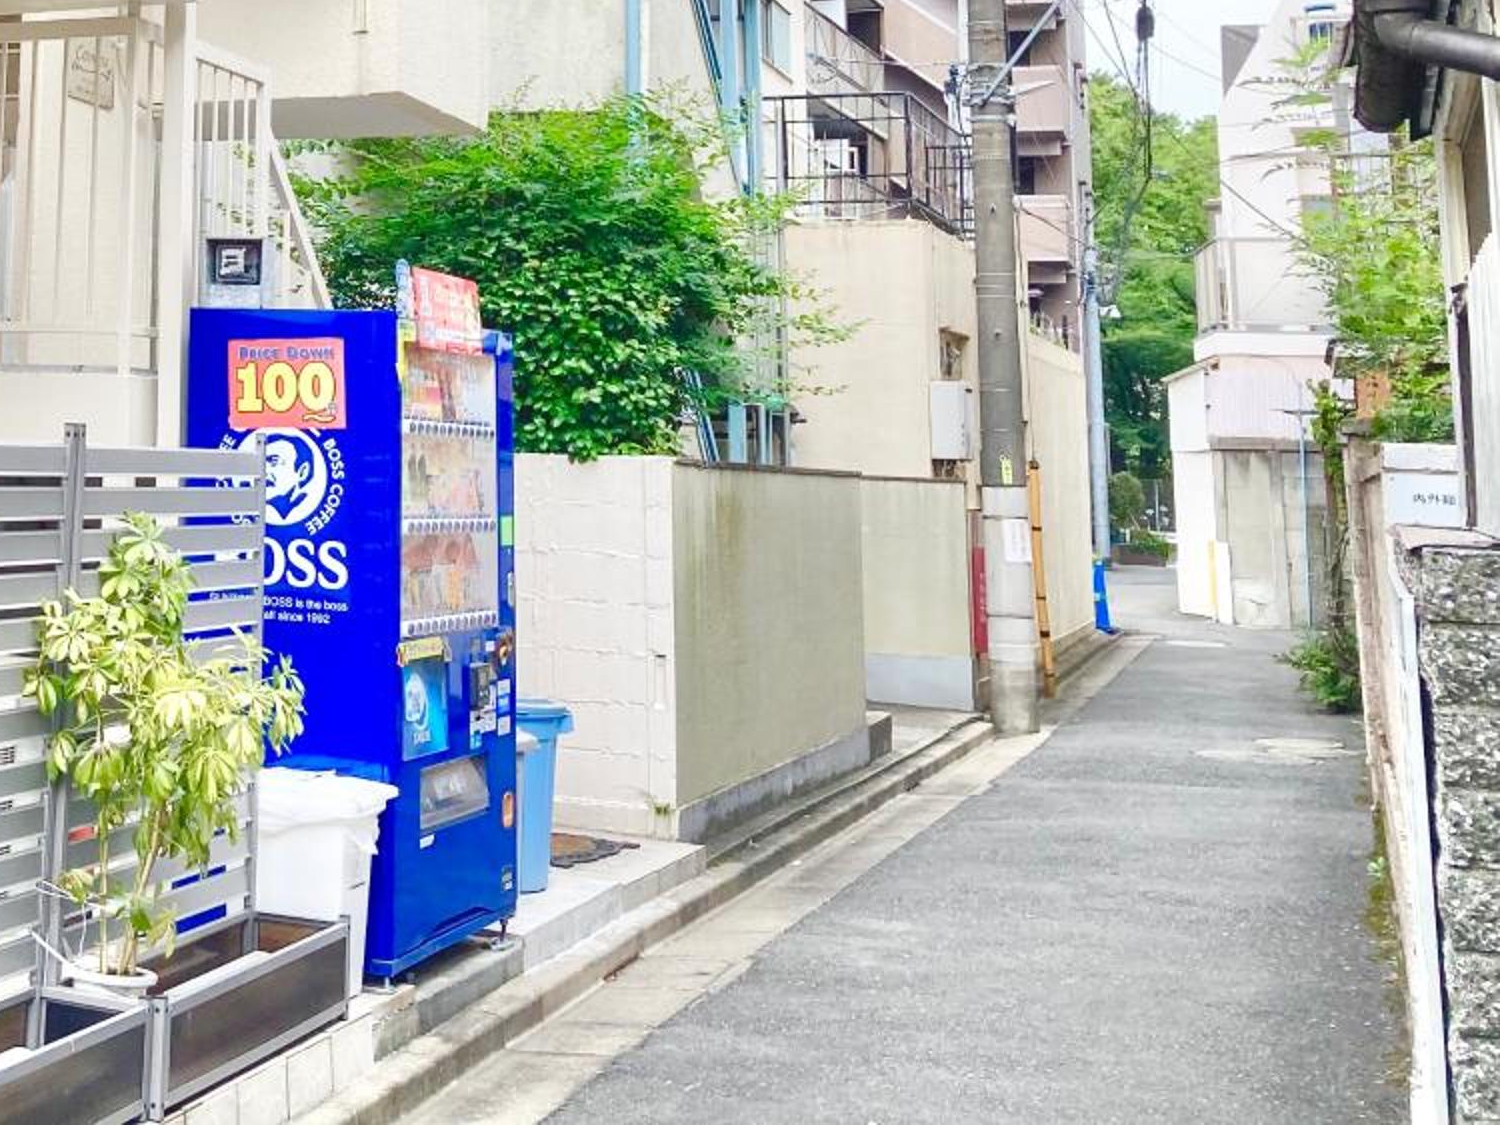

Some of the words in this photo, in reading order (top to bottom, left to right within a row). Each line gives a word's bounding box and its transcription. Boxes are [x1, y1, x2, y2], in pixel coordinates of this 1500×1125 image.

[236, 360, 336, 413] 100
[323, 438, 345, 479] BOSS
[305, 484, 344, 536] COFFEE
[250, 536, 349, 590] OSS
